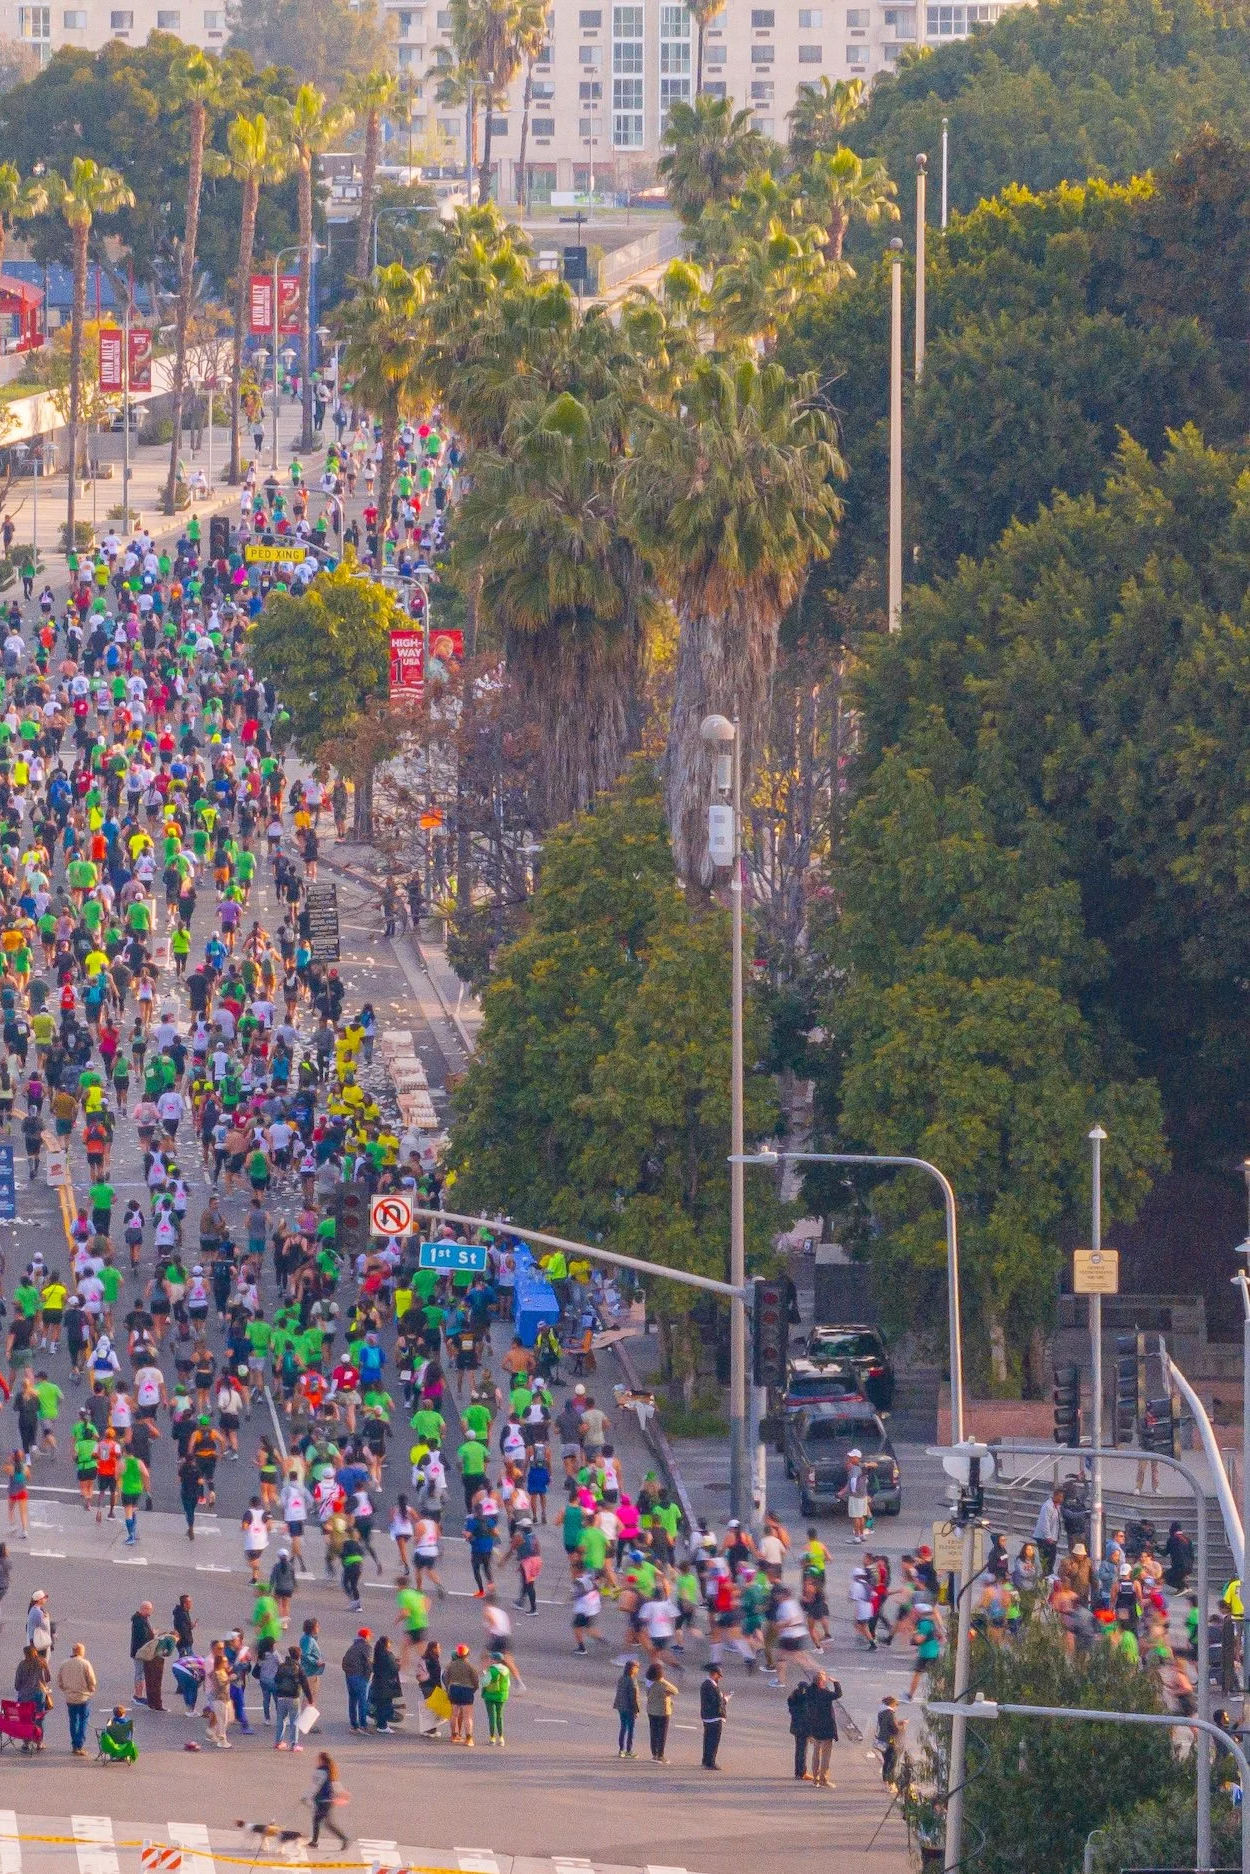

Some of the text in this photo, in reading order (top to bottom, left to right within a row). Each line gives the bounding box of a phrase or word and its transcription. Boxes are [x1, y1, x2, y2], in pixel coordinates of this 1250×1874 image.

[253, 284, 264, 326] ALVIN AILEY
[102, 339, 114, 383] ALVIN AILEY
[251, 549, 300, 560] PED XING
[391, 638, 423, 648] HIGH-
[397, 648, 423, 657] WAY
[402, 658, 421, 666] USA
[391, 657, 406, 685] 1
[430, 1247, 477, 1265] 1st St
